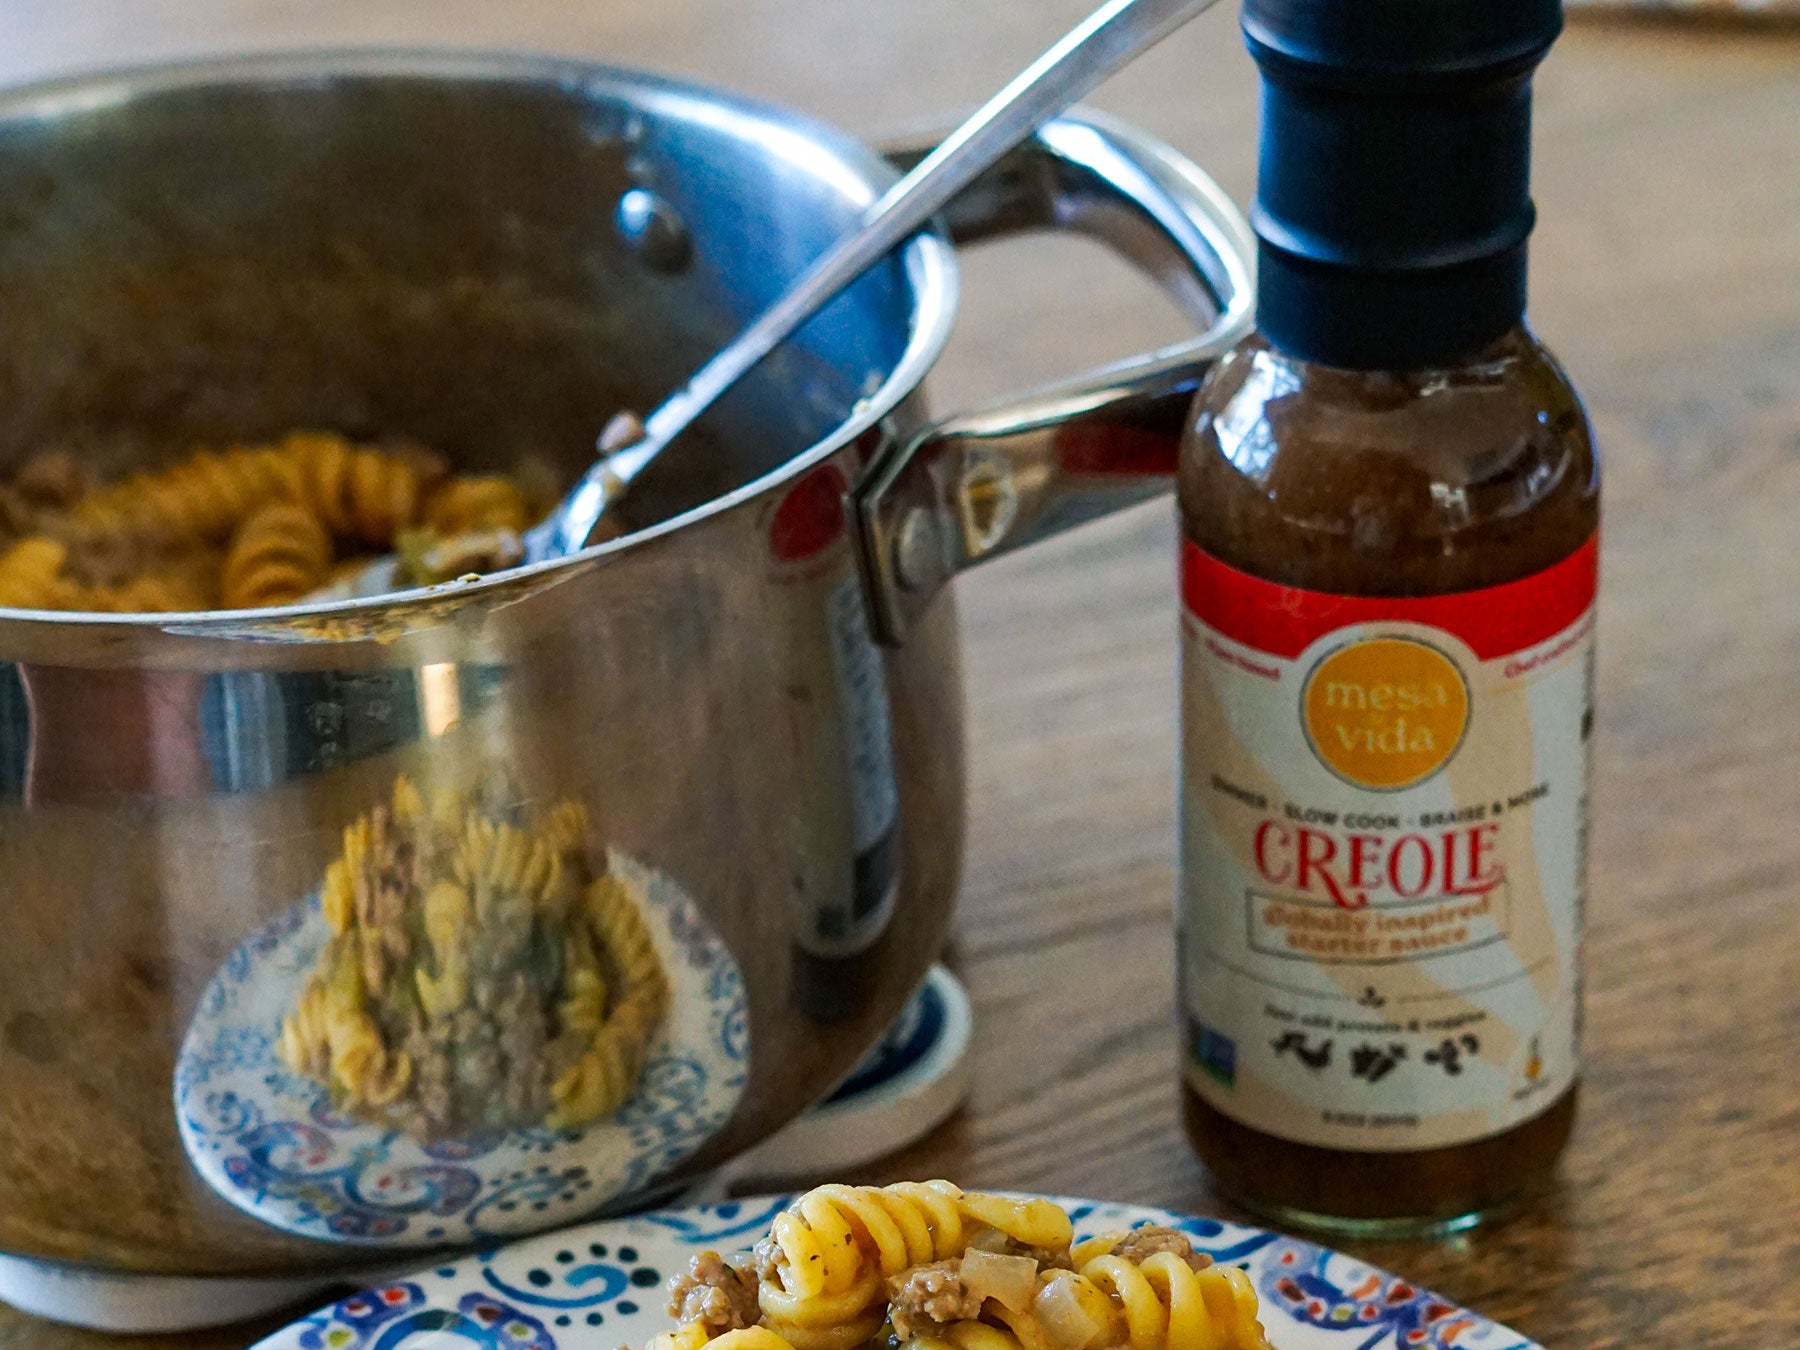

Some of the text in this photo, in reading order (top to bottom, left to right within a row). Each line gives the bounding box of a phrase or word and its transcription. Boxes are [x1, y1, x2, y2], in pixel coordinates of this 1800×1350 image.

[1327, 681, 1447, 711] mesa
[1335, 717, 1436, 754] vida
[1284, 801, 1338, 826] SLOW
[1343, 812, 1399, 830] COOK
[1253, 817, 1507, 912] CREOLE
[1389, 926, 1467, 954] sauce
